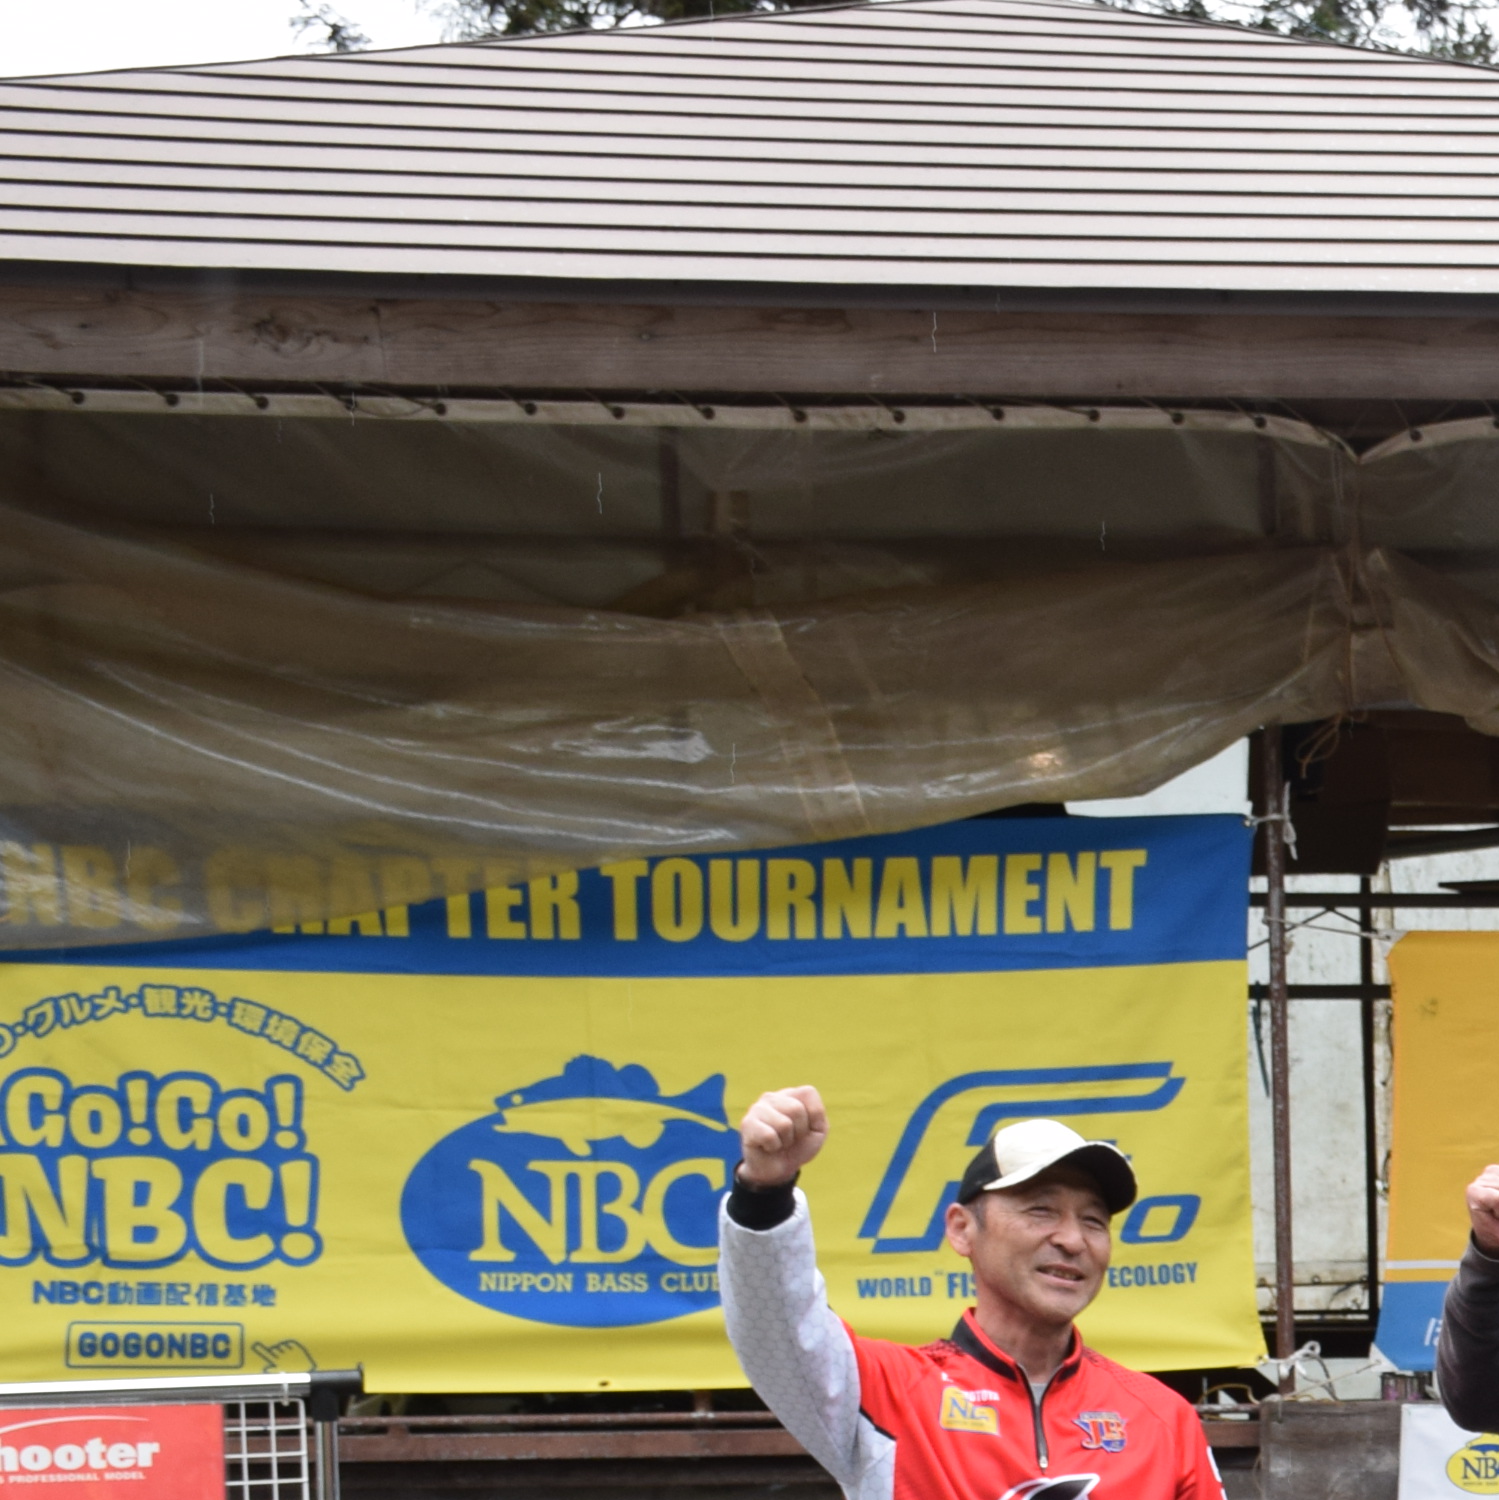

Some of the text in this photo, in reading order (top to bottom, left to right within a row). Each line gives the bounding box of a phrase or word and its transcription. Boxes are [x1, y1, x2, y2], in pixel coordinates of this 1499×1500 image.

[601, 848, 1148, 943] TOURNAMENT
[4, 1068, 303, 1153] Go!Go!
[0, 1152, 322, 1270] NBC!
[468, 1158, 726, 1267] NBC
[479, 1271, 573, 1292] NIPPON
[586, 1271, 648, 1293] BASS
[857, 1276, 932, 1299] WORLD
[1108, 1262, 1198, 1288] ECOLOGY
[77, 1332, 232, 1359] GOGONBC
[0, 1438, 160, 1472] hooter
[9, 1471, 146, 1483] PROFESSIONAL MODEL
